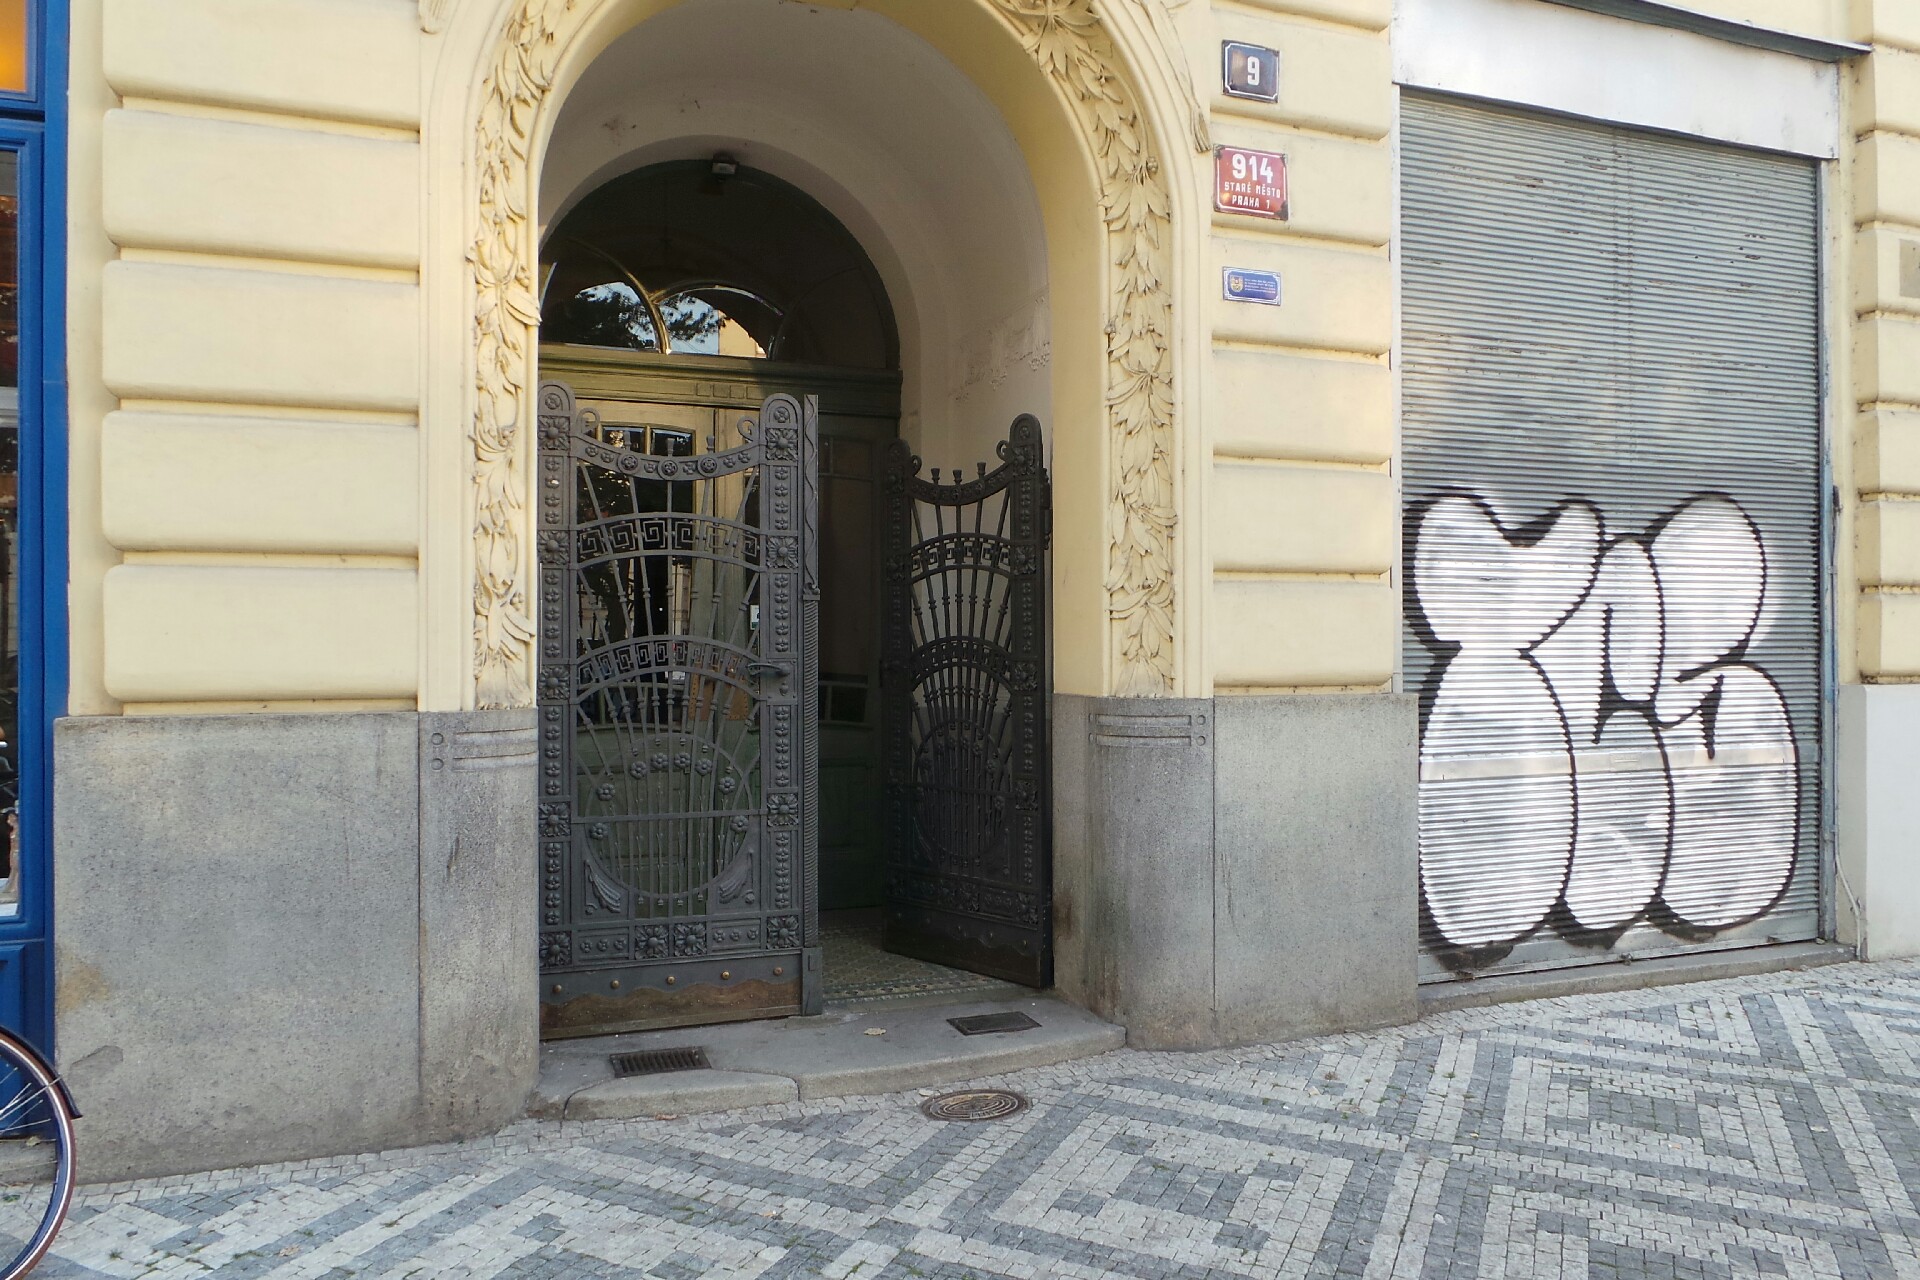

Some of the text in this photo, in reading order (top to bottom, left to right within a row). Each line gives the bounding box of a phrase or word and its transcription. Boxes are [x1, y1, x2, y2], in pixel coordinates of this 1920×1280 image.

[1247, 56, 1260, 86] 9
[1232, 153, 1273, 184] 914
[1224, 181, 1251, 193] STARÉ
[1232, 194, 1271, 209] PRAHA 1
